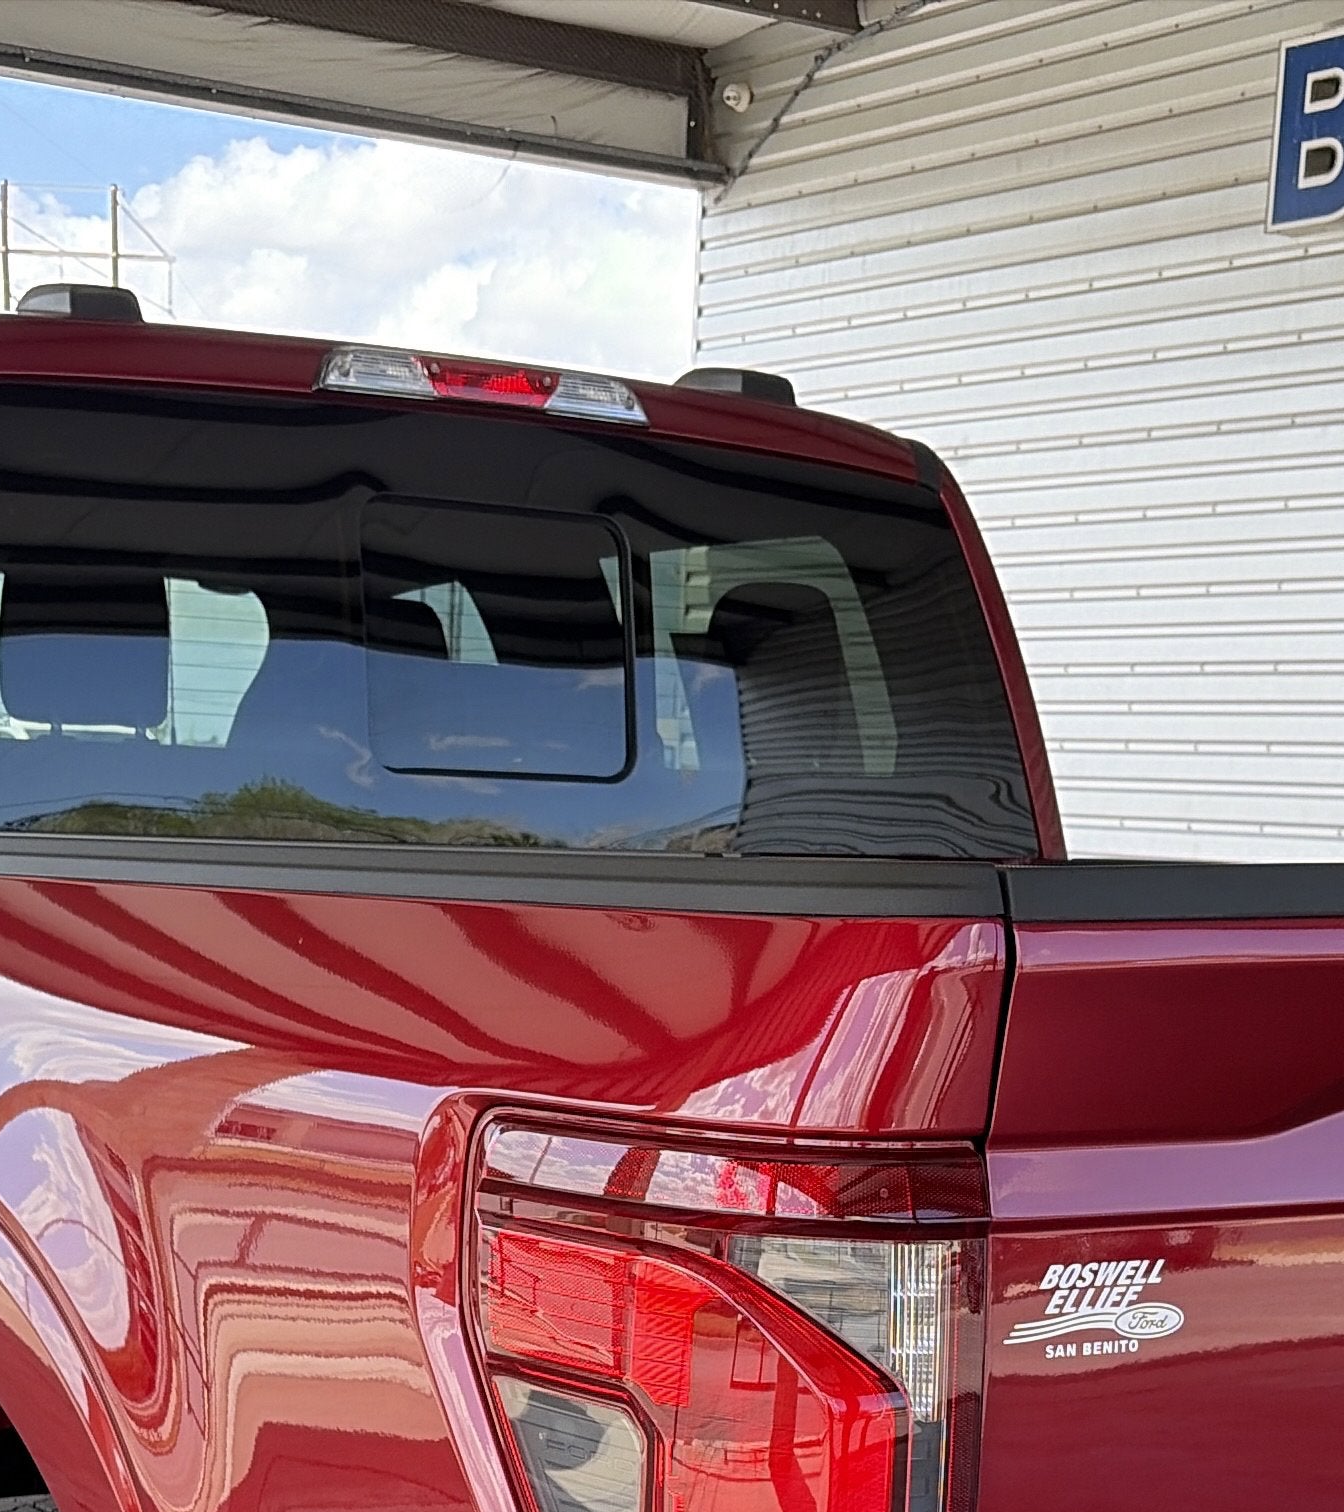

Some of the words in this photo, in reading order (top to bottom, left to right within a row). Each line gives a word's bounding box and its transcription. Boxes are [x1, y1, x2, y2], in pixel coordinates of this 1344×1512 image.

[1039, 1259, 1165, 1290] BOSWELL
[1045, 1285, 1143, 1315] ELLIFF
[1128, 1311, 1167, 1330] Ford
[1045, 1343, 1076, 1359] SAN
[1082, 1339, 1139, 1356] BENITO
